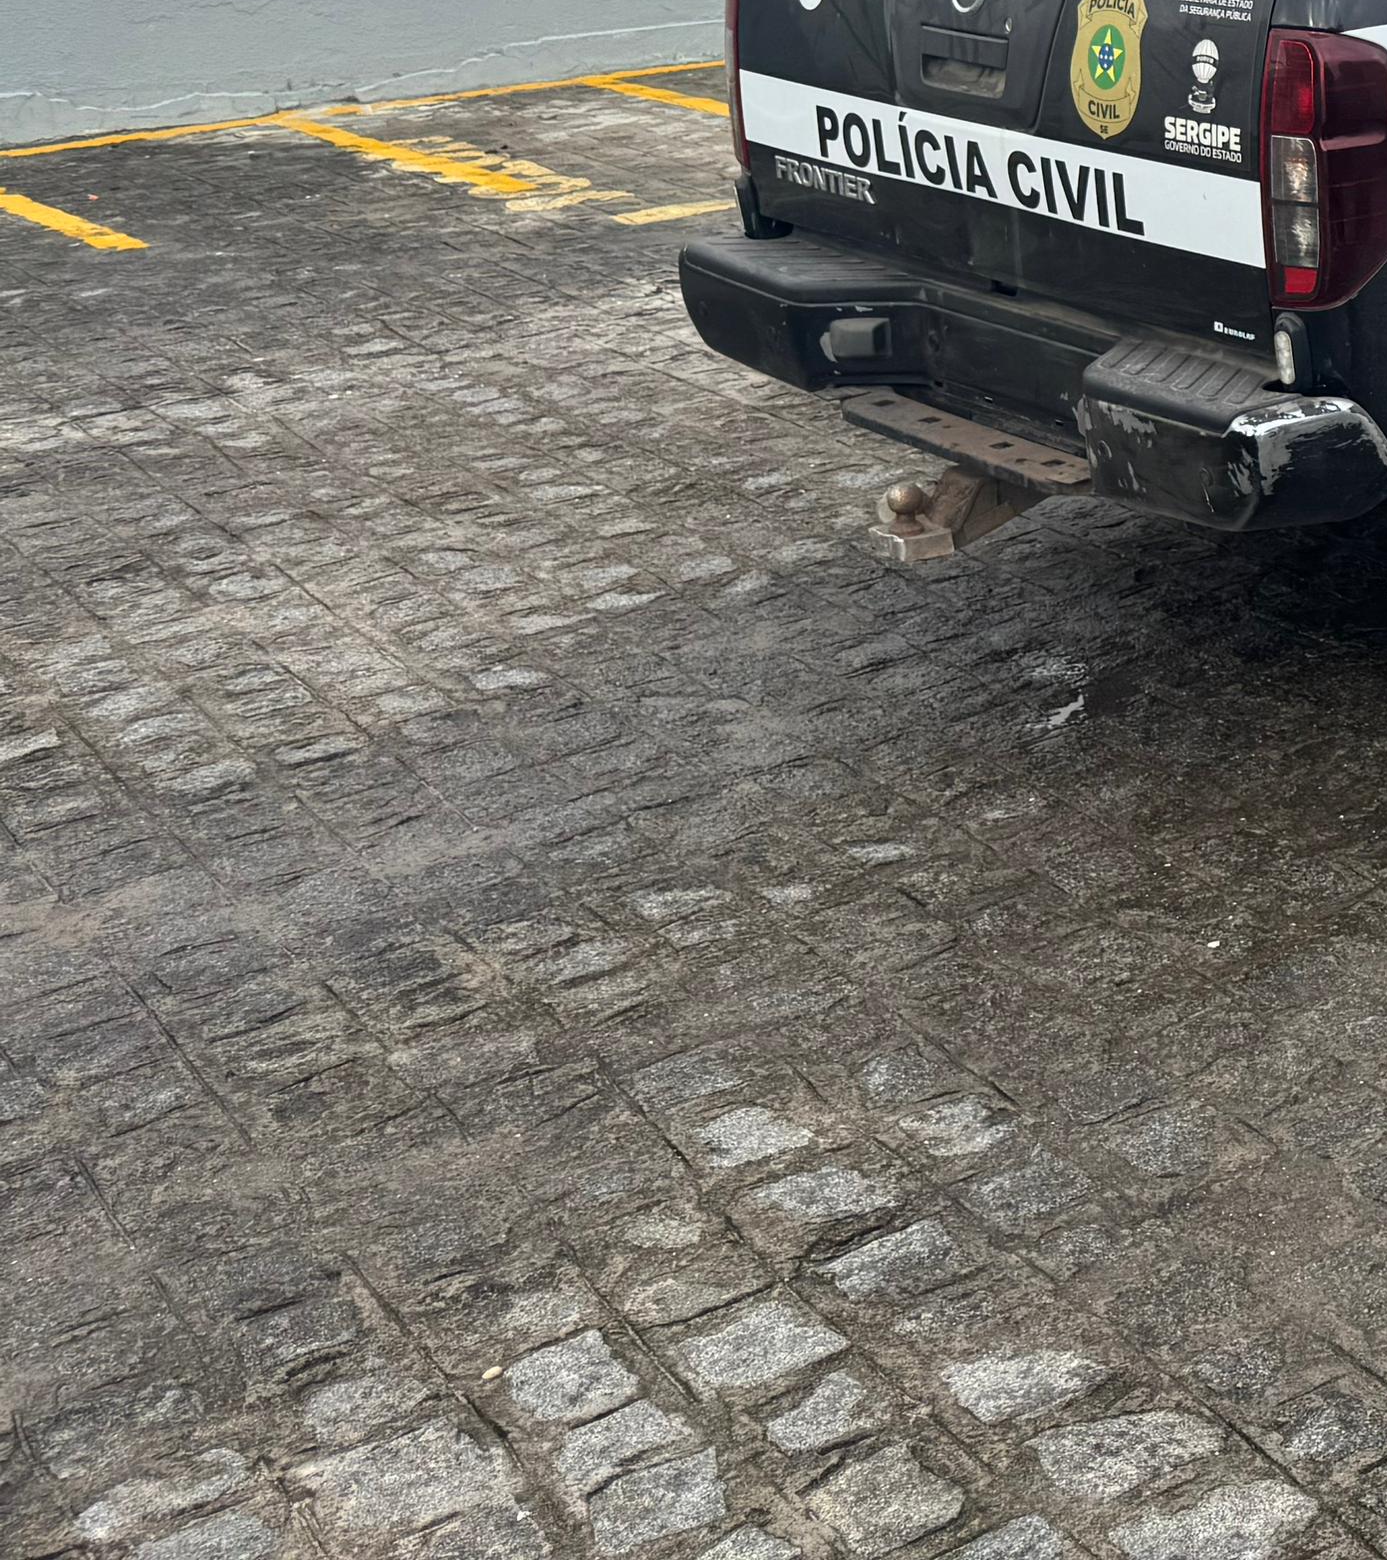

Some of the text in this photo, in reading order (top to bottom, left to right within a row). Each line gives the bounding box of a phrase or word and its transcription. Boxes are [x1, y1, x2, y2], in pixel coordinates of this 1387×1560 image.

[1179, 4, 1252, 21] DA SEGURANÇA PÚBLICA
[1087, 99, 1121, 120] CIVIL
[1164, 116, 1241, 151] SERGIPE
[1164, 140, 1242, 163] GOVERNO DO ESTADO
[774, 154, 876, 205] FRONTIER
[815, 104, 1145, 236] POLÍCIA CIVIL
